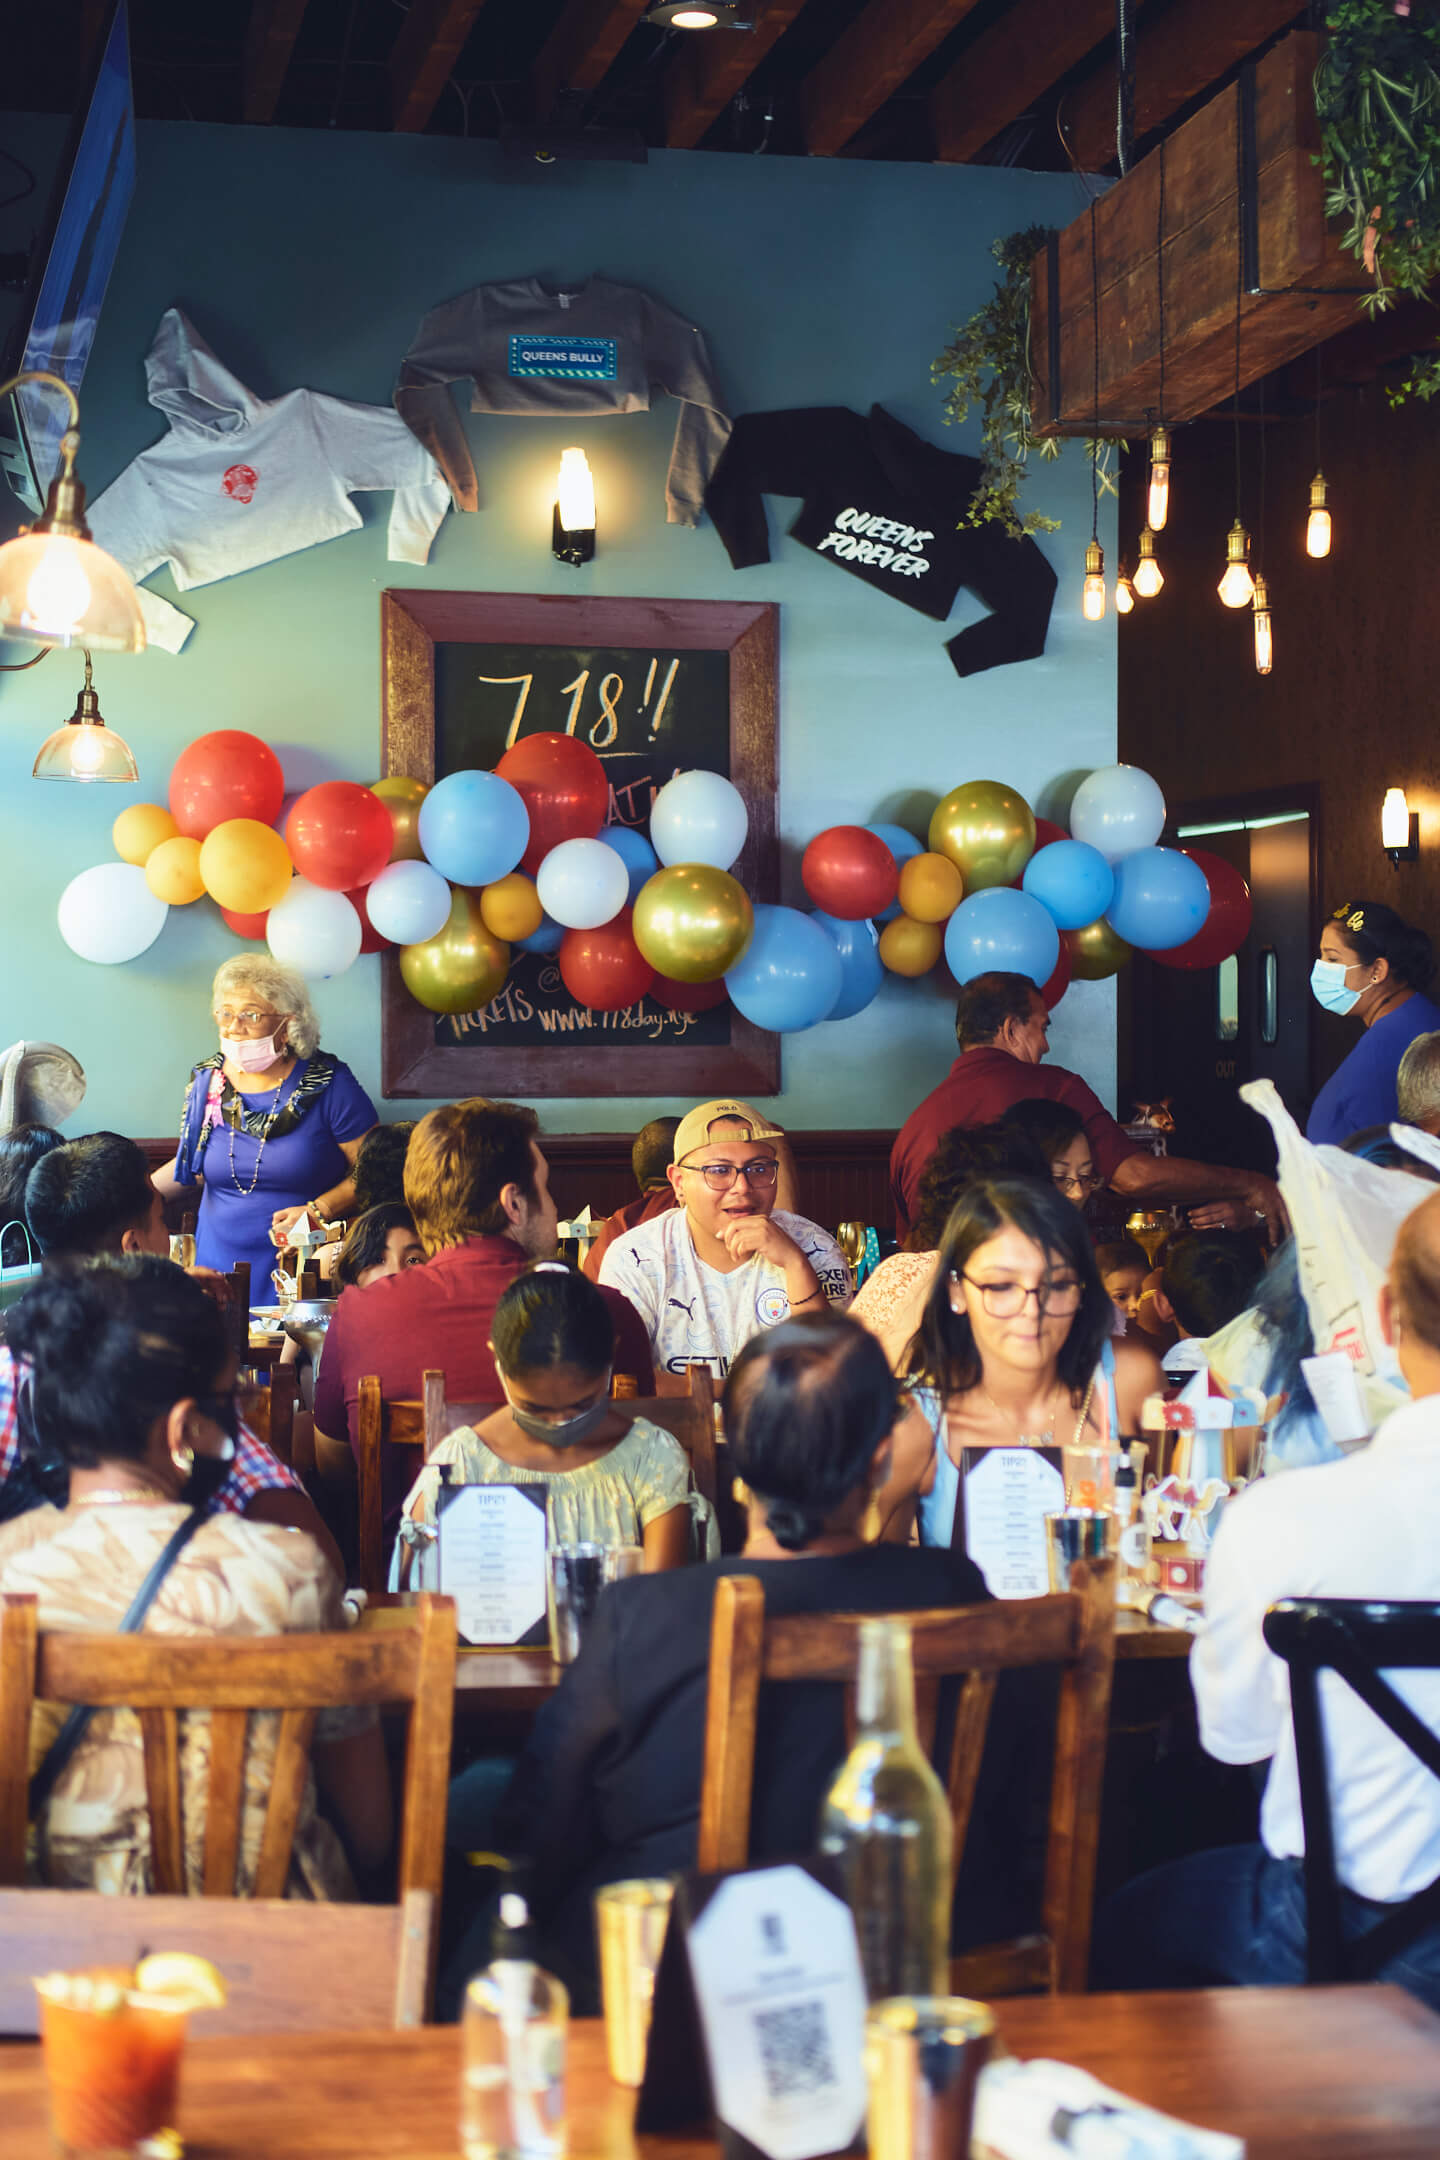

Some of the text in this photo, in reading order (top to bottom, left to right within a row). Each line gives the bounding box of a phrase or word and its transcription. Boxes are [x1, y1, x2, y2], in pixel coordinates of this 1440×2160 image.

[521, 351, 604, 363] QUEENS BULLY
[835, 507, 934, 553] QUEENS
[816, 531, 930, 579] FOREVER
[1215, 1060, 1237, 1078] OUT
[716, 1104, 738, 1112] POLO
